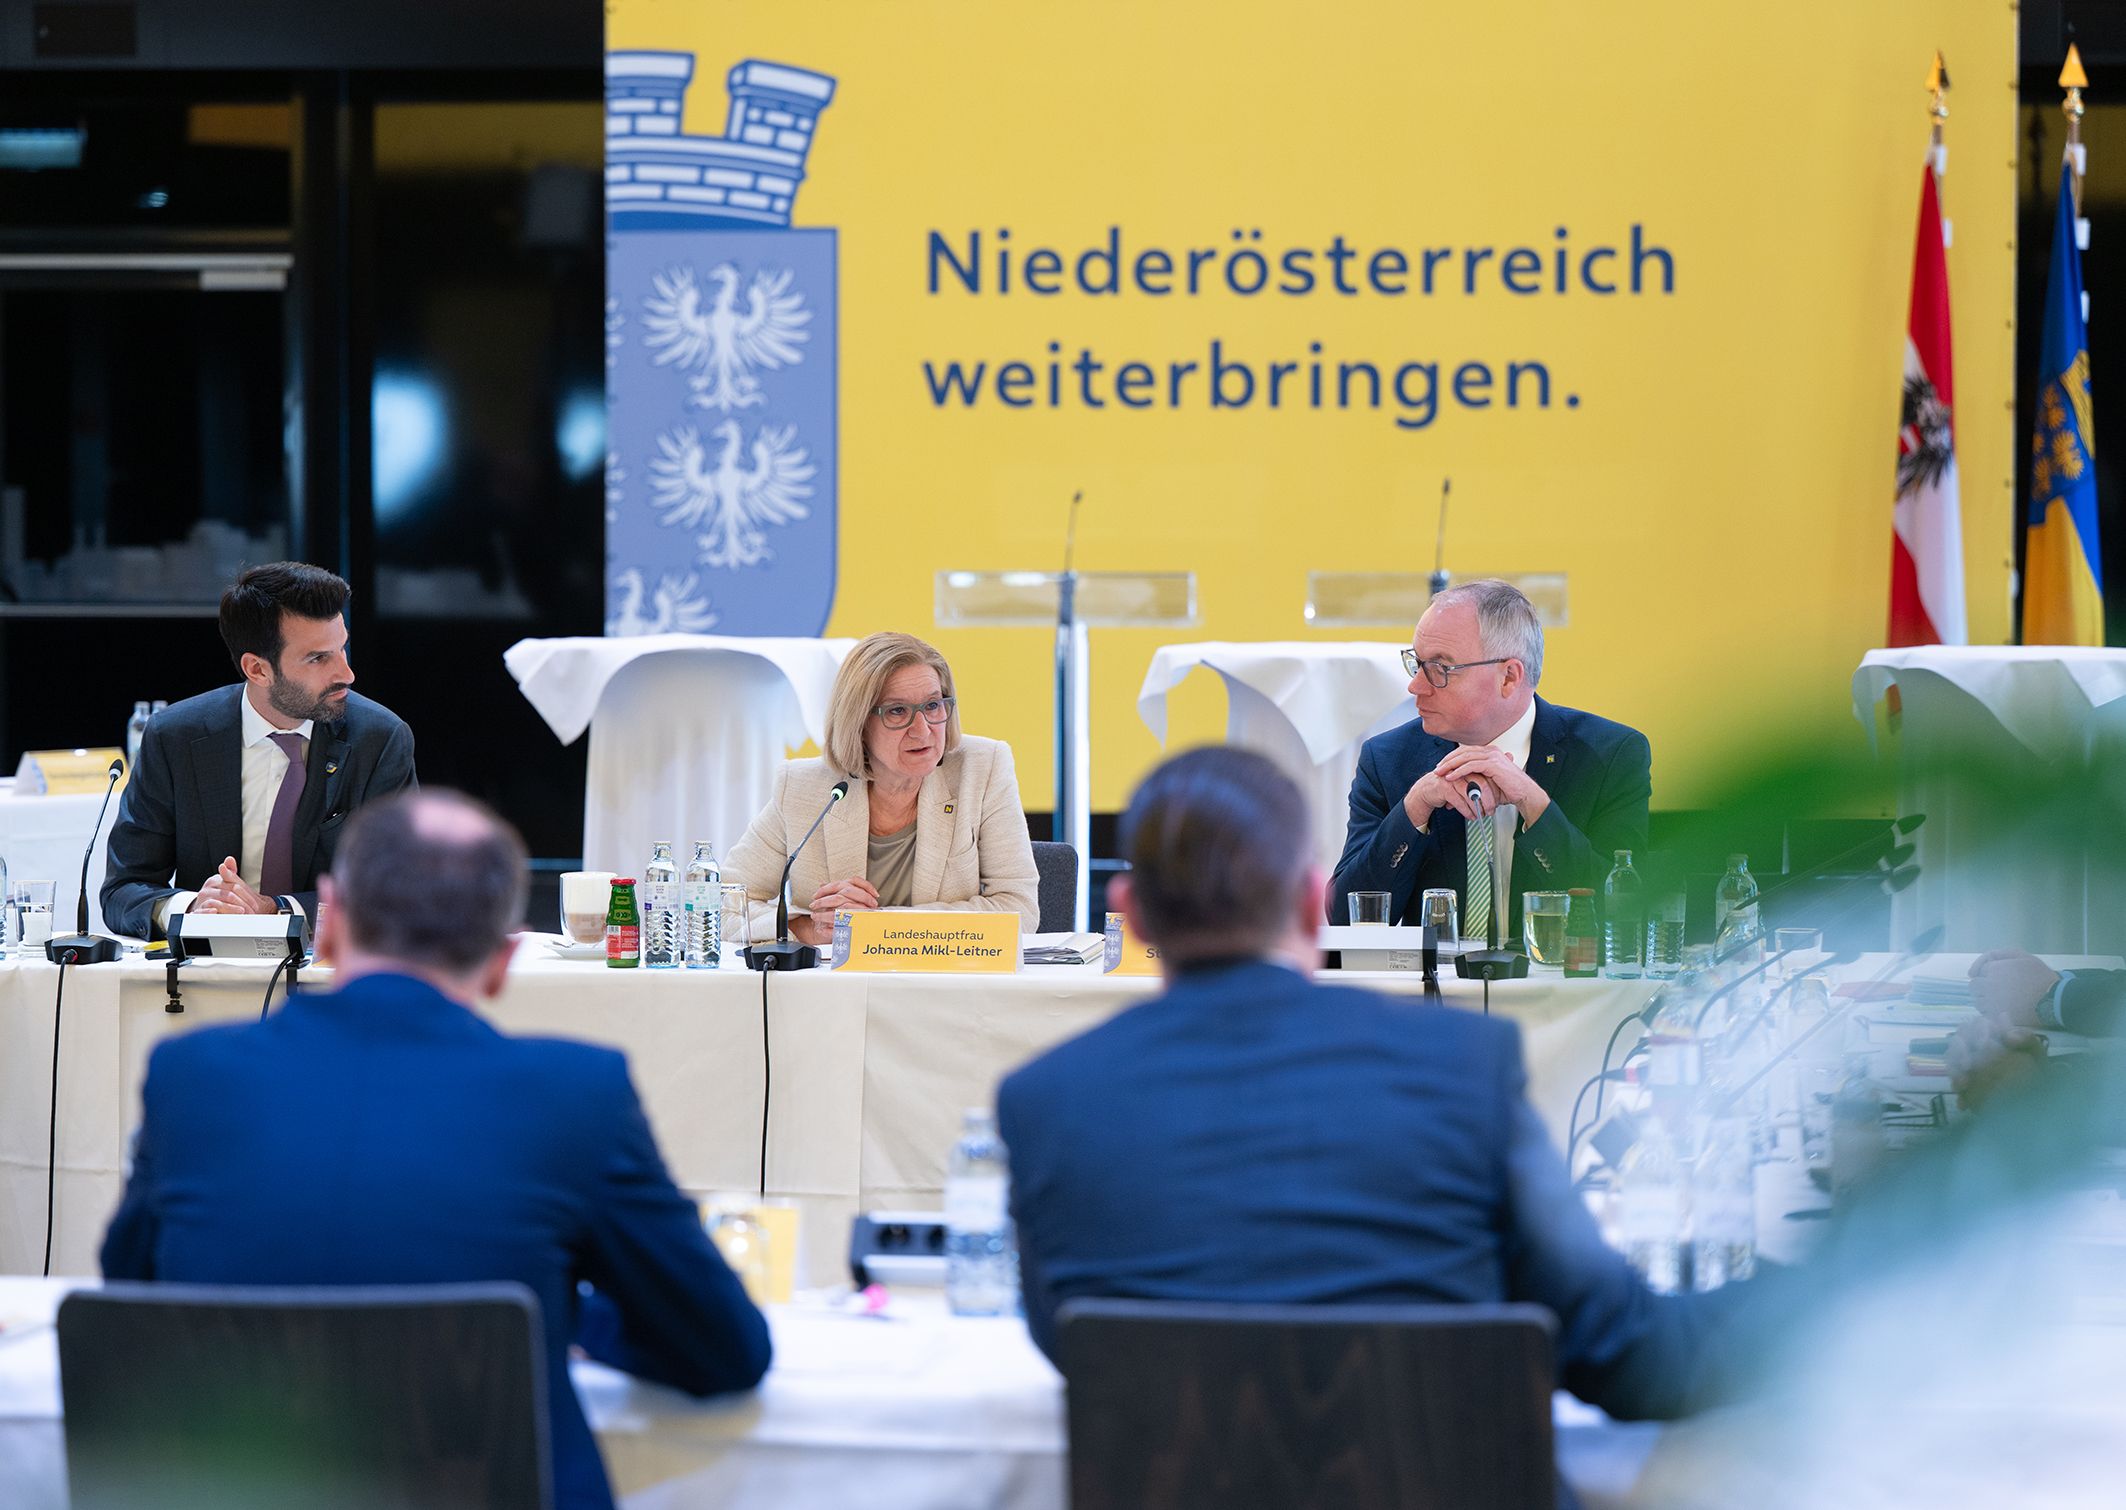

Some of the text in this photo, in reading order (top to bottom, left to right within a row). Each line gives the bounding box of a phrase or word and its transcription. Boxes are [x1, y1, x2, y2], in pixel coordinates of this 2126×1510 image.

[926, 223, 1676, 296] Niederösterreich
[921, 339, 1581, 430] weiterbringen.
[862, 944, 1003, 957] Johanna Mikl-Leitner
[883, 929, 985, 941] Landeshauptfrau
